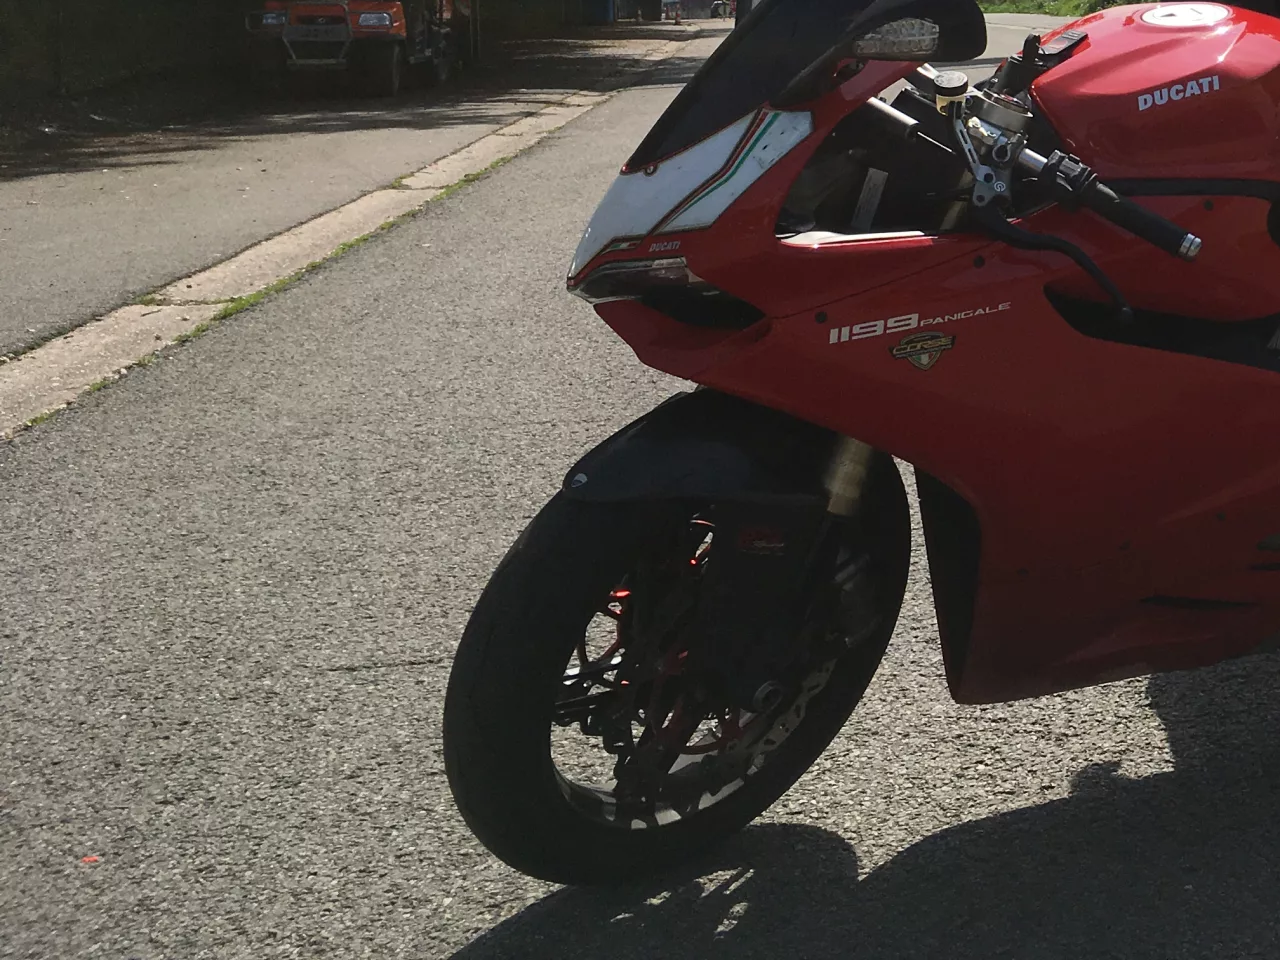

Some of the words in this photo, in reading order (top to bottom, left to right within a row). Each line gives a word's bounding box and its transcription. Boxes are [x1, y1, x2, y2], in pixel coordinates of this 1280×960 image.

[1137, 75, 1220, 111] DUCATI
[829, 313, 919, 344] 1199
[920, 301, 1012, 327] PANIGALE
